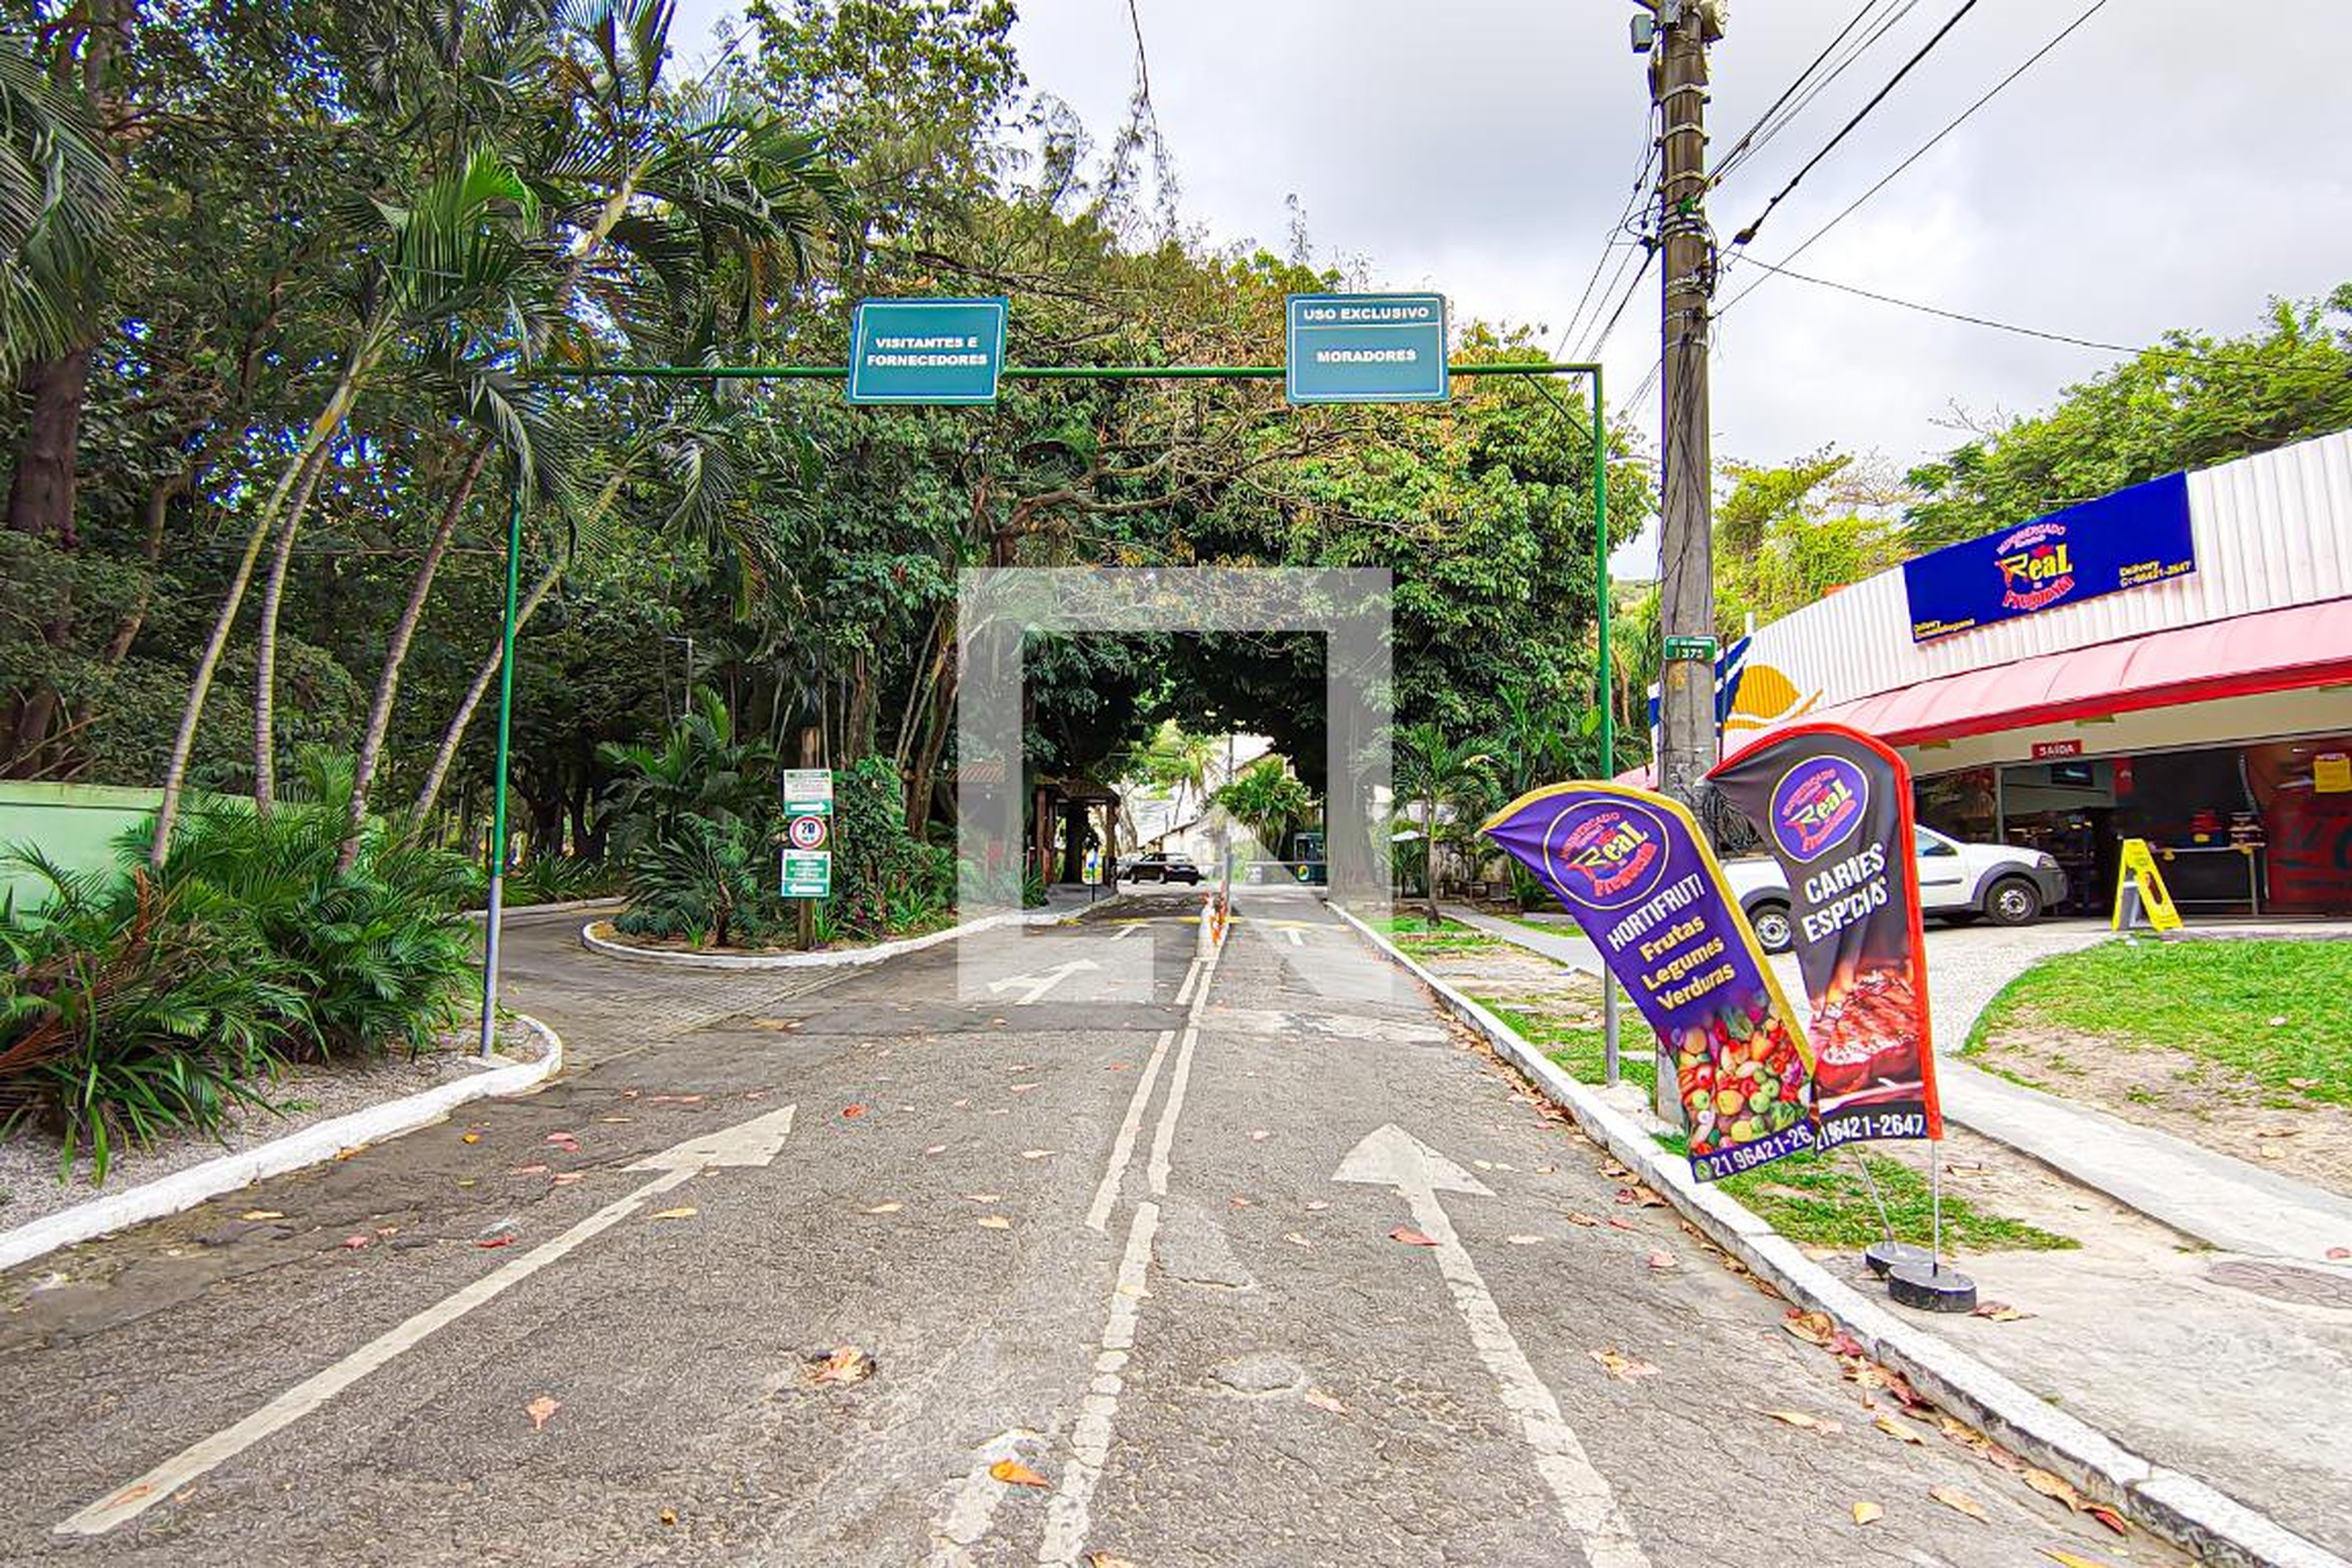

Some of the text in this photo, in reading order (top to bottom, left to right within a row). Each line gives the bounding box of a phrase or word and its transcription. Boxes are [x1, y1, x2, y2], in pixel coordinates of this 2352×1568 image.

[1303, 307, 1429, 320] USO EXCLUSIVO
[875, 336, 979, 349] VISITANTES E
[867, 354, 987, 366] FORNECEDORES
[1317, 349, 1416, 362] MORADORES
[1607, 873, 1706, 952] HORTIFRUTI
[1639, 916, 1706, 962] Frutas
[1641, 937, 1725, 991] Legumes
[1656, 963, 1735, 1010] Verduras
[1710, 1154, 1735, 1177] 21
